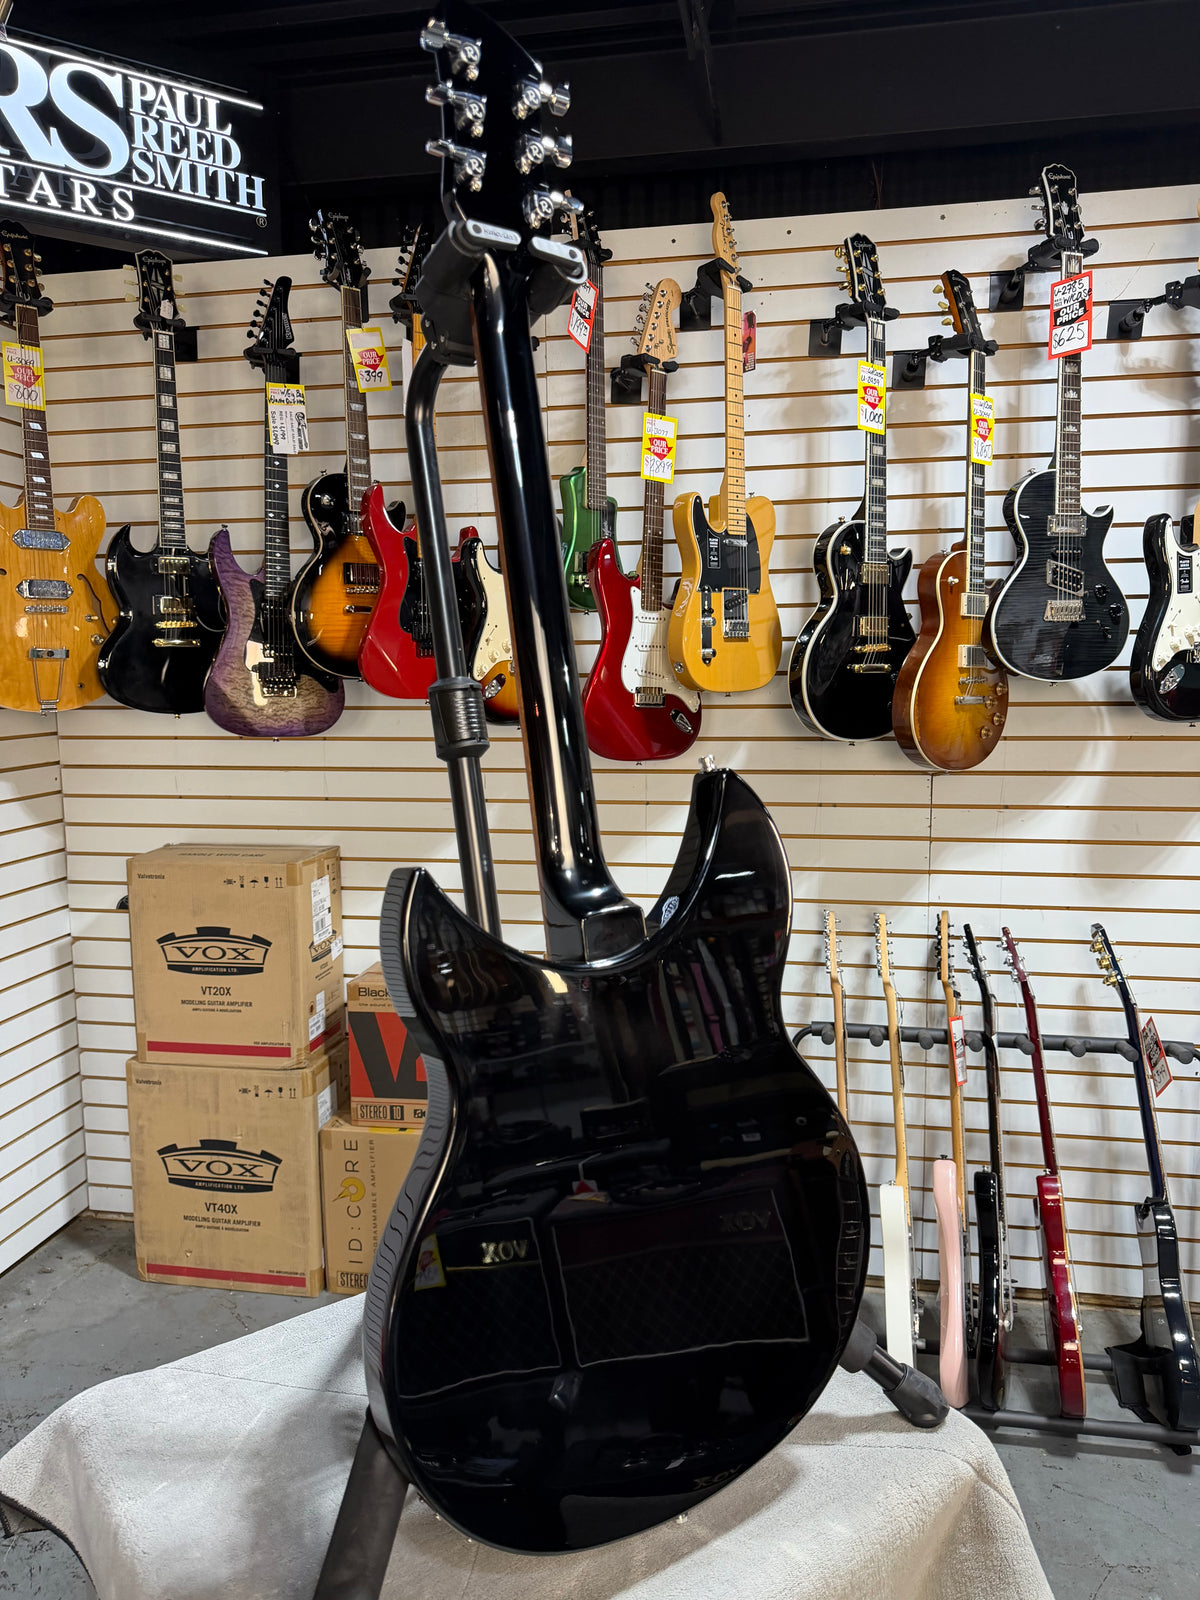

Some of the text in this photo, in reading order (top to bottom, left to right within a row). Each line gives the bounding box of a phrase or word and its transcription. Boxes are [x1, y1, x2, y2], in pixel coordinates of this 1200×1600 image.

[128, 77, 233, 137] PAUL
[131, 112, 242, 170] REED
[131, 150, 267, 212] SMITH
[1059, 302, 1081, 317] OUR
[1056, 307, 1085, 326] PRICE
[1052, 322, 1086, 349] $625
[362, 351, 378, 359] OUR
[362, 357, 381, 366] PRICE
[14, 373, 36, 383] PRICE
[16, 367, 34, 377] OUR
[359, 369, 383, 383] $399
[9, 383, 39, 402] $800
[866, 387, 879, 397] OUR
[864, 395, 881, 405] PRICE
[978, 420, 989, 429] OUR
[976, 426, 990, 436] PRICE
[652, 438, 667, 448] OUR
[650, 446, 669, 455] PRICE
[171, 945, 255, 961] VOX
[201, 986, 232, 996] VT20X
[360, 1105, 387, 1119] STEREO
[173, 1159, 264, 1178] VOX
[368, 1140, 377, 1187] AMPLIFIER
[205, 1202, 238, 1214] VT40X
[183, 1215, 261, 1227] MODELING GUITAR AMPLIFIER
